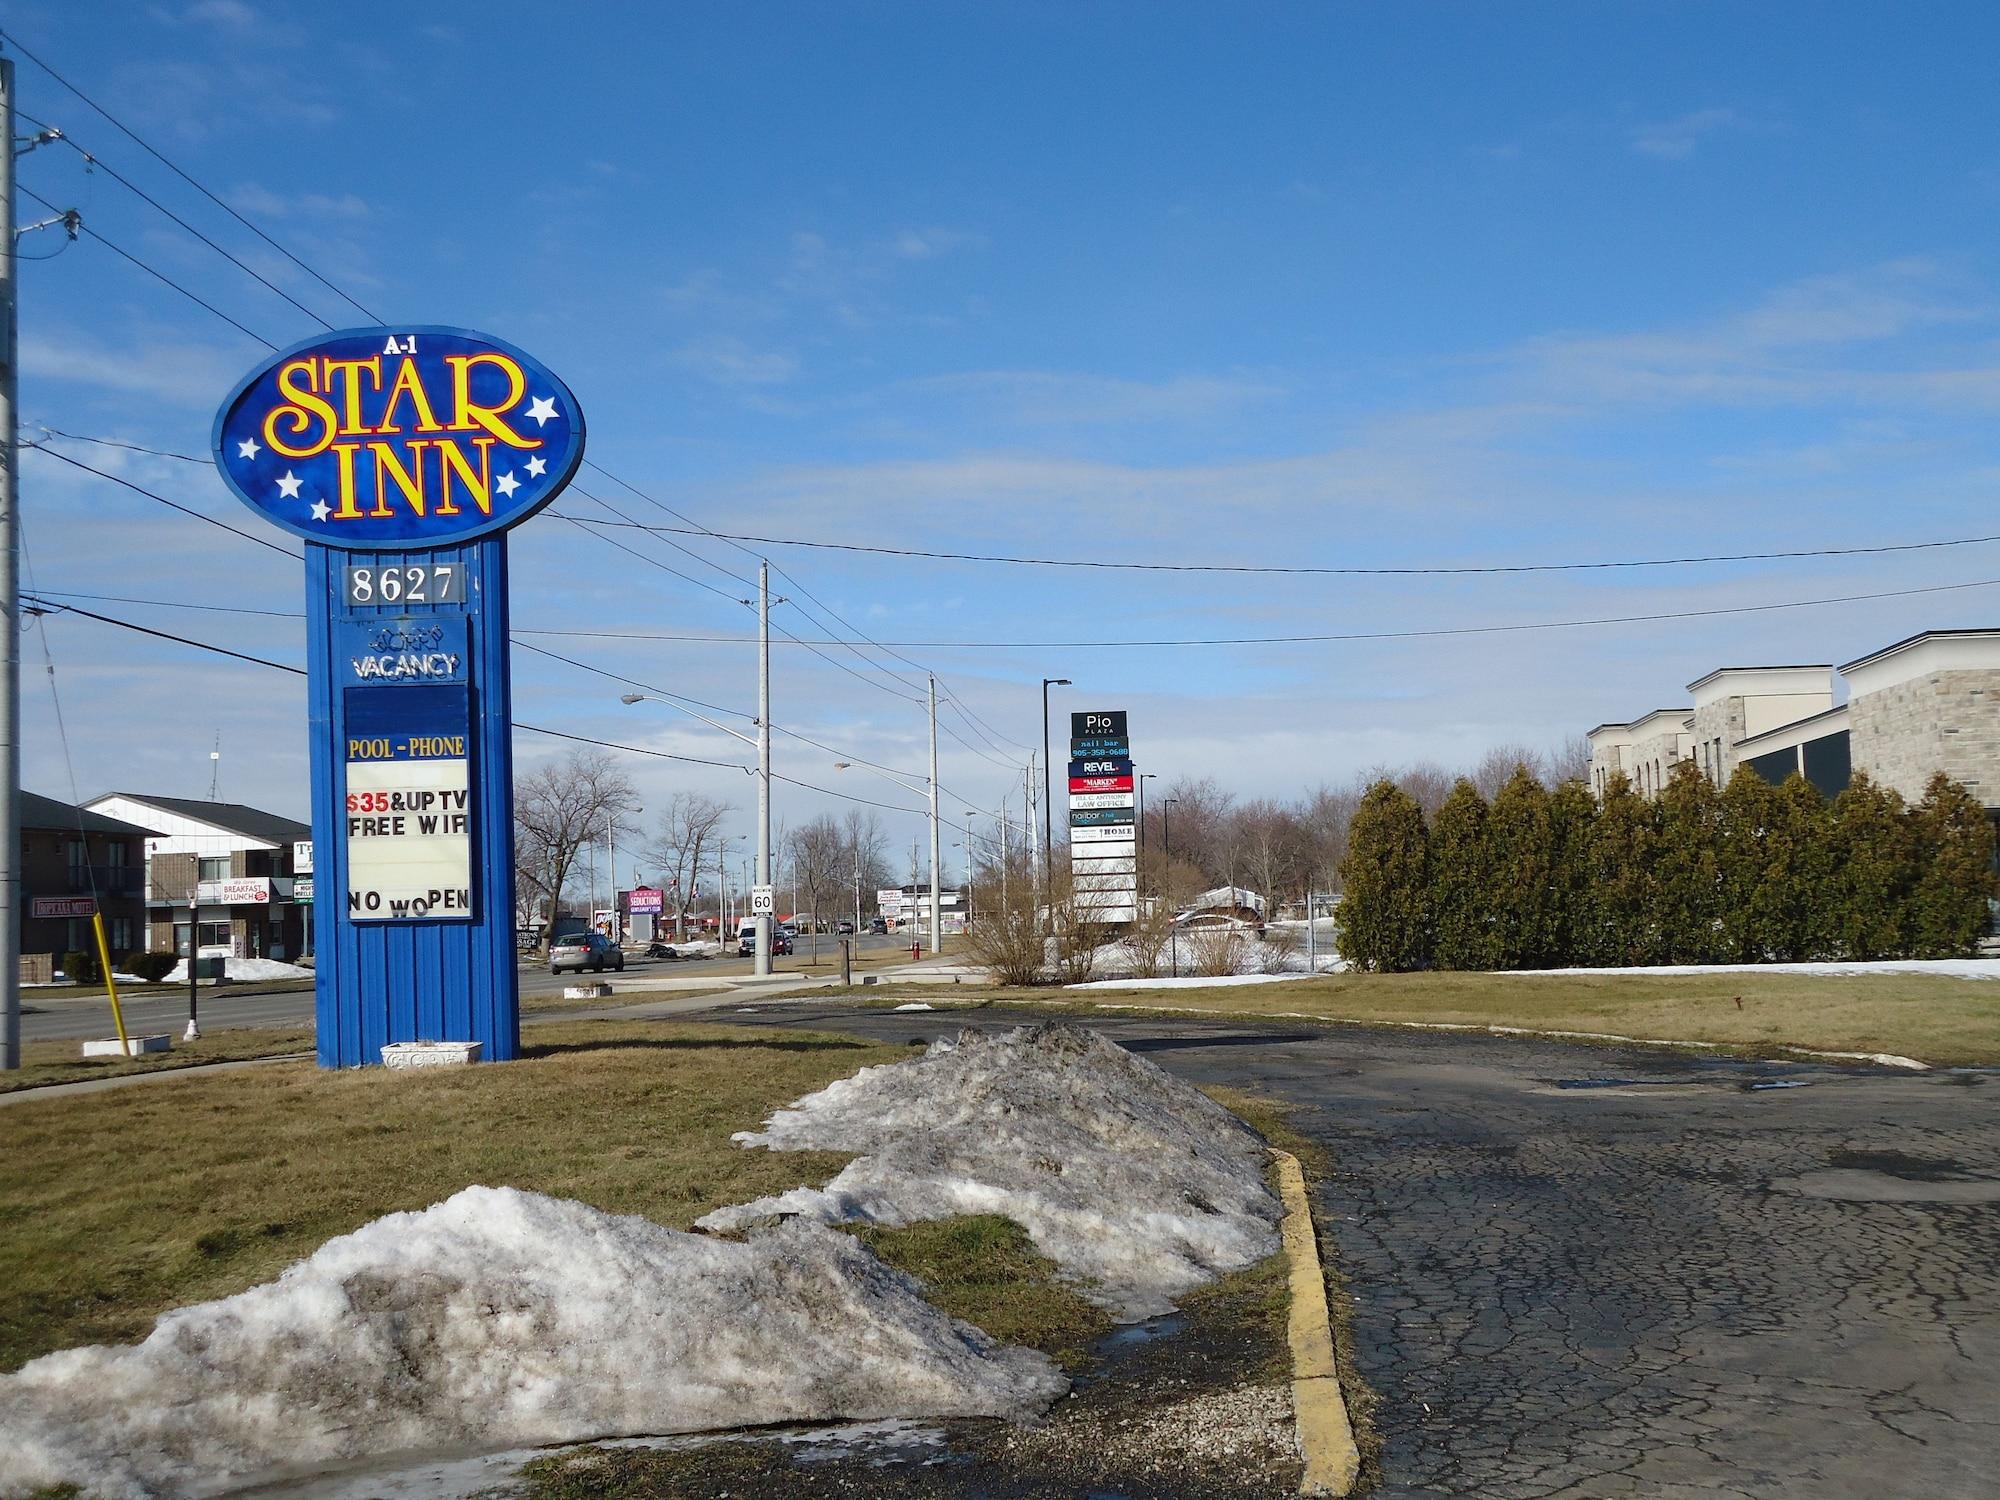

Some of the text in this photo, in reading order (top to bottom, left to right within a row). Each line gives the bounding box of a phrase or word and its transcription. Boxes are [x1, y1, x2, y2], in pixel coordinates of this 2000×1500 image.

[383, 335, 418, 355] A-1
[263, 353, 544, 458] STAR
[330, 437, 497, 518] INN
[352, 567, 452, 602] 8627
[351, 653, 457, 678] VACANCY
[1086, 715, 1112, 728] Pio
[348, 739, 394, 759] POOL
[408, 736, 465, 756] PHONE
[1103, 739, 1119, 747] bar
[1083, 761, 1116, 772] REVEL
[438, 789, 468, 810] TV
[348, 816, 405, 837] FREE
[224, 884, 262, 893] BREAKFAST
[231, 893, 254, 901] LUNCH
[348, 891, 381, 911] NO
[630, 896, 661, 906] SEDUCTIONS
[755, 896, 771, 908] 60
